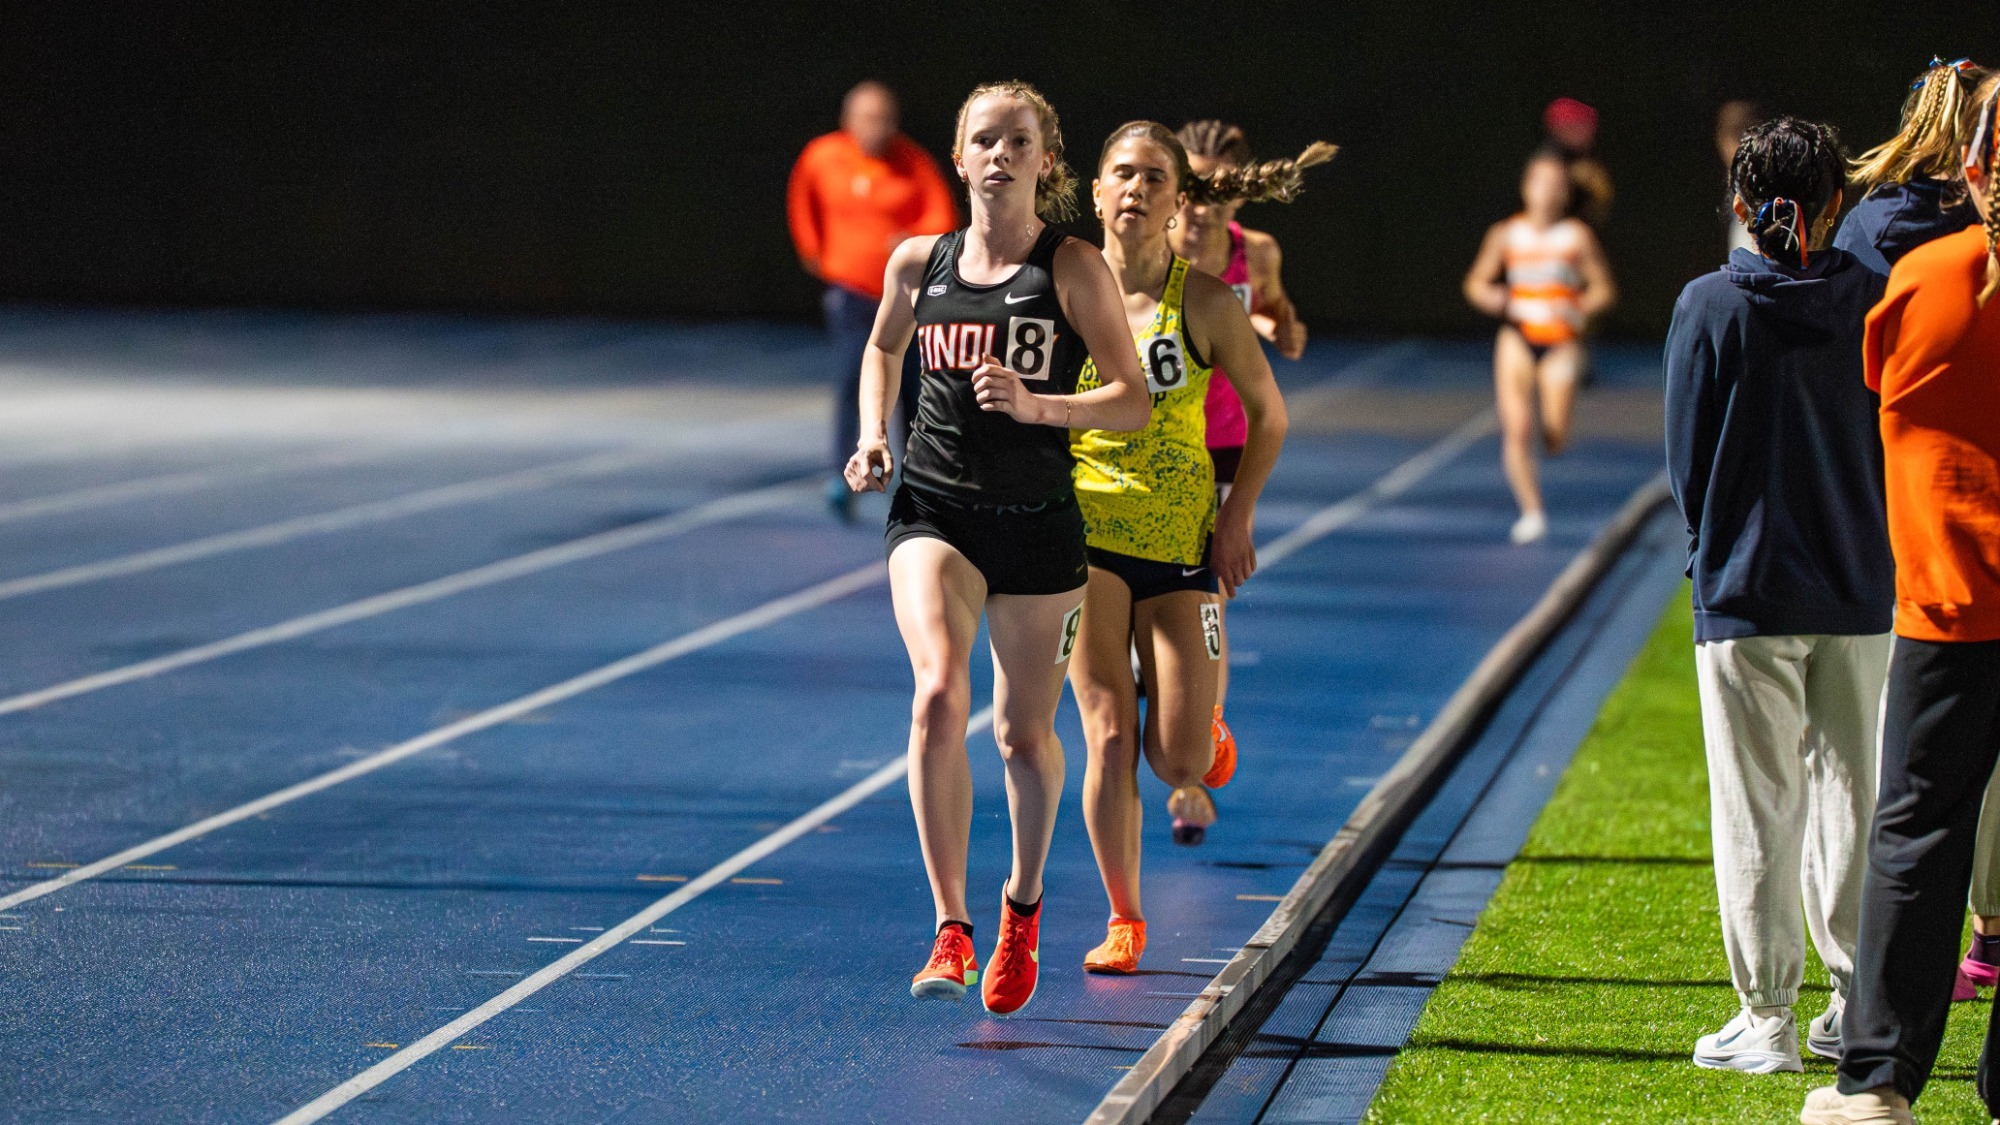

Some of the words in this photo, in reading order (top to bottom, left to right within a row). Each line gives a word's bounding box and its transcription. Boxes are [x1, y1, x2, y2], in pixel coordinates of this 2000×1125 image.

[1011, 322, 1046, 375] 8
[1149, 338, 1182, 388] 6
[1062, 607, 1082, 656] 8
